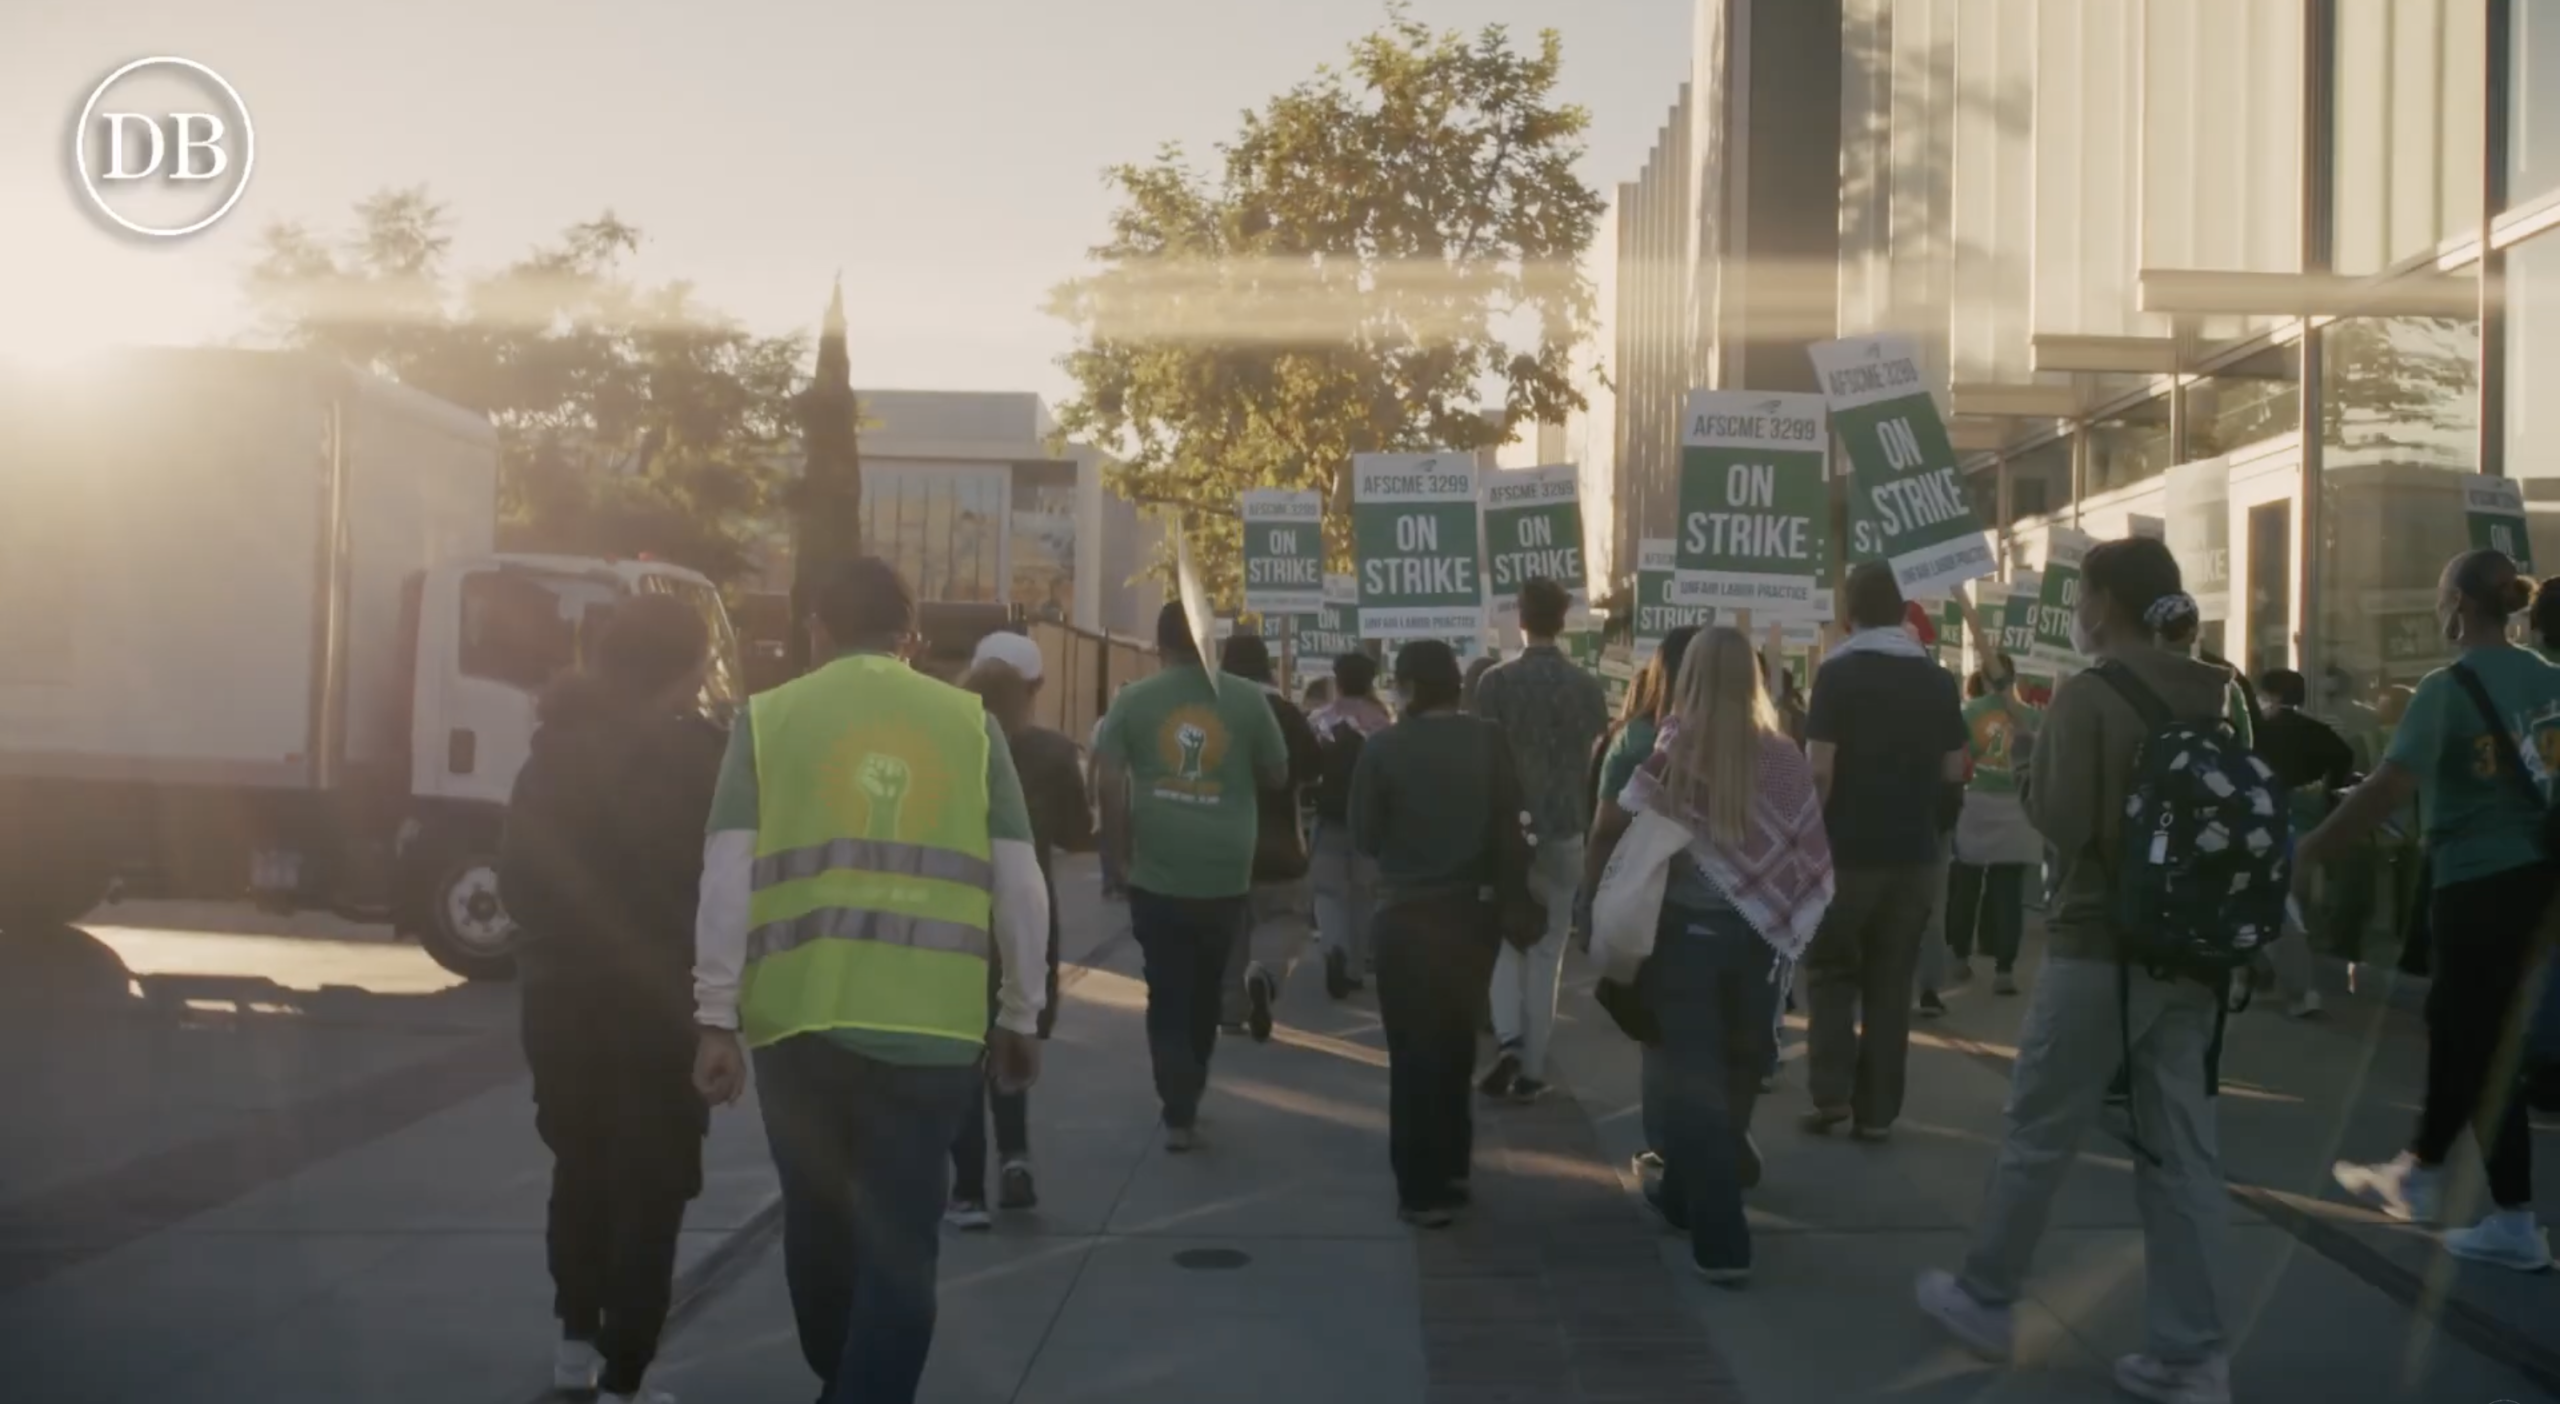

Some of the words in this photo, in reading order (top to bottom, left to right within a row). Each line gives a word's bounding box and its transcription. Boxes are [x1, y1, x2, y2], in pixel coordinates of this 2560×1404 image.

[1692, 415, 1766, 439] AFSCME
[1770, 417, 1816, 441] 3299
[1876, 416, 1924, 470] ON
[1363, 475, 1424, 495] AFSCME
[1428, 474, 1469, 494] 3299
[1490, 483, 1538, 500] AFSCME
[1726, 464, 1774, 507] ON
[1871, 466, 1970, 537] STRIKE
[1268, 529, 1297, 555] ON
[1396, 514, 1438, 551] ON
[1518, 515, 1551, 547] ON
[1685, 511, 1811, 559] STRIKE
[1249, 557, 1318, 583] STRIKE
[1365, 557, 1473, 595] STRIKE
[1495, 547, 1581, 585] STRIKE
[1318, 608, 1340, 629] ON
[1640, 606, 1708, 631] STRIKE
[1300, 630, 1357, 653] STRIKE
